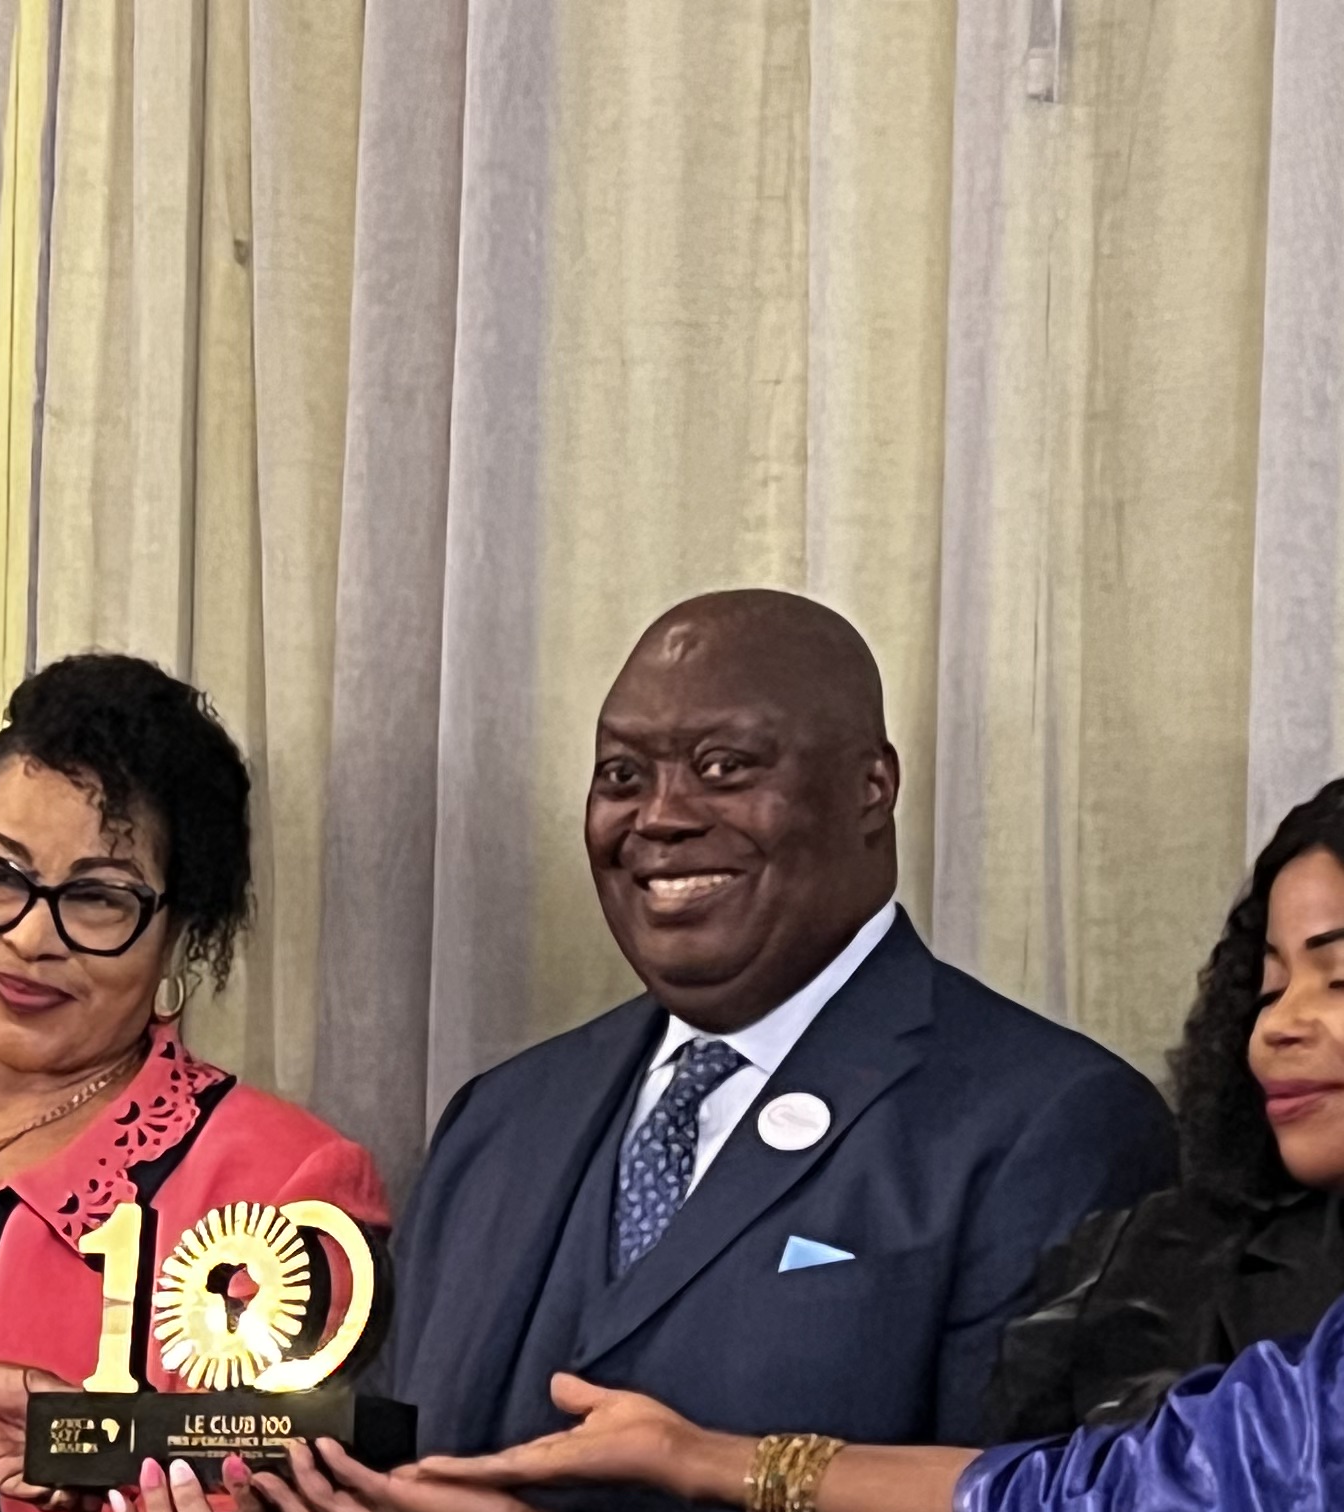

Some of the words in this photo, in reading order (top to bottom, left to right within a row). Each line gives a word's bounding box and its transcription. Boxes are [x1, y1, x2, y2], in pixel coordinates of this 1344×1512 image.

[185, 1415, 205, 1434] LE
[210, 1415, 256, 1434] CLUB
[261, 1414, 292, 1435] 100
